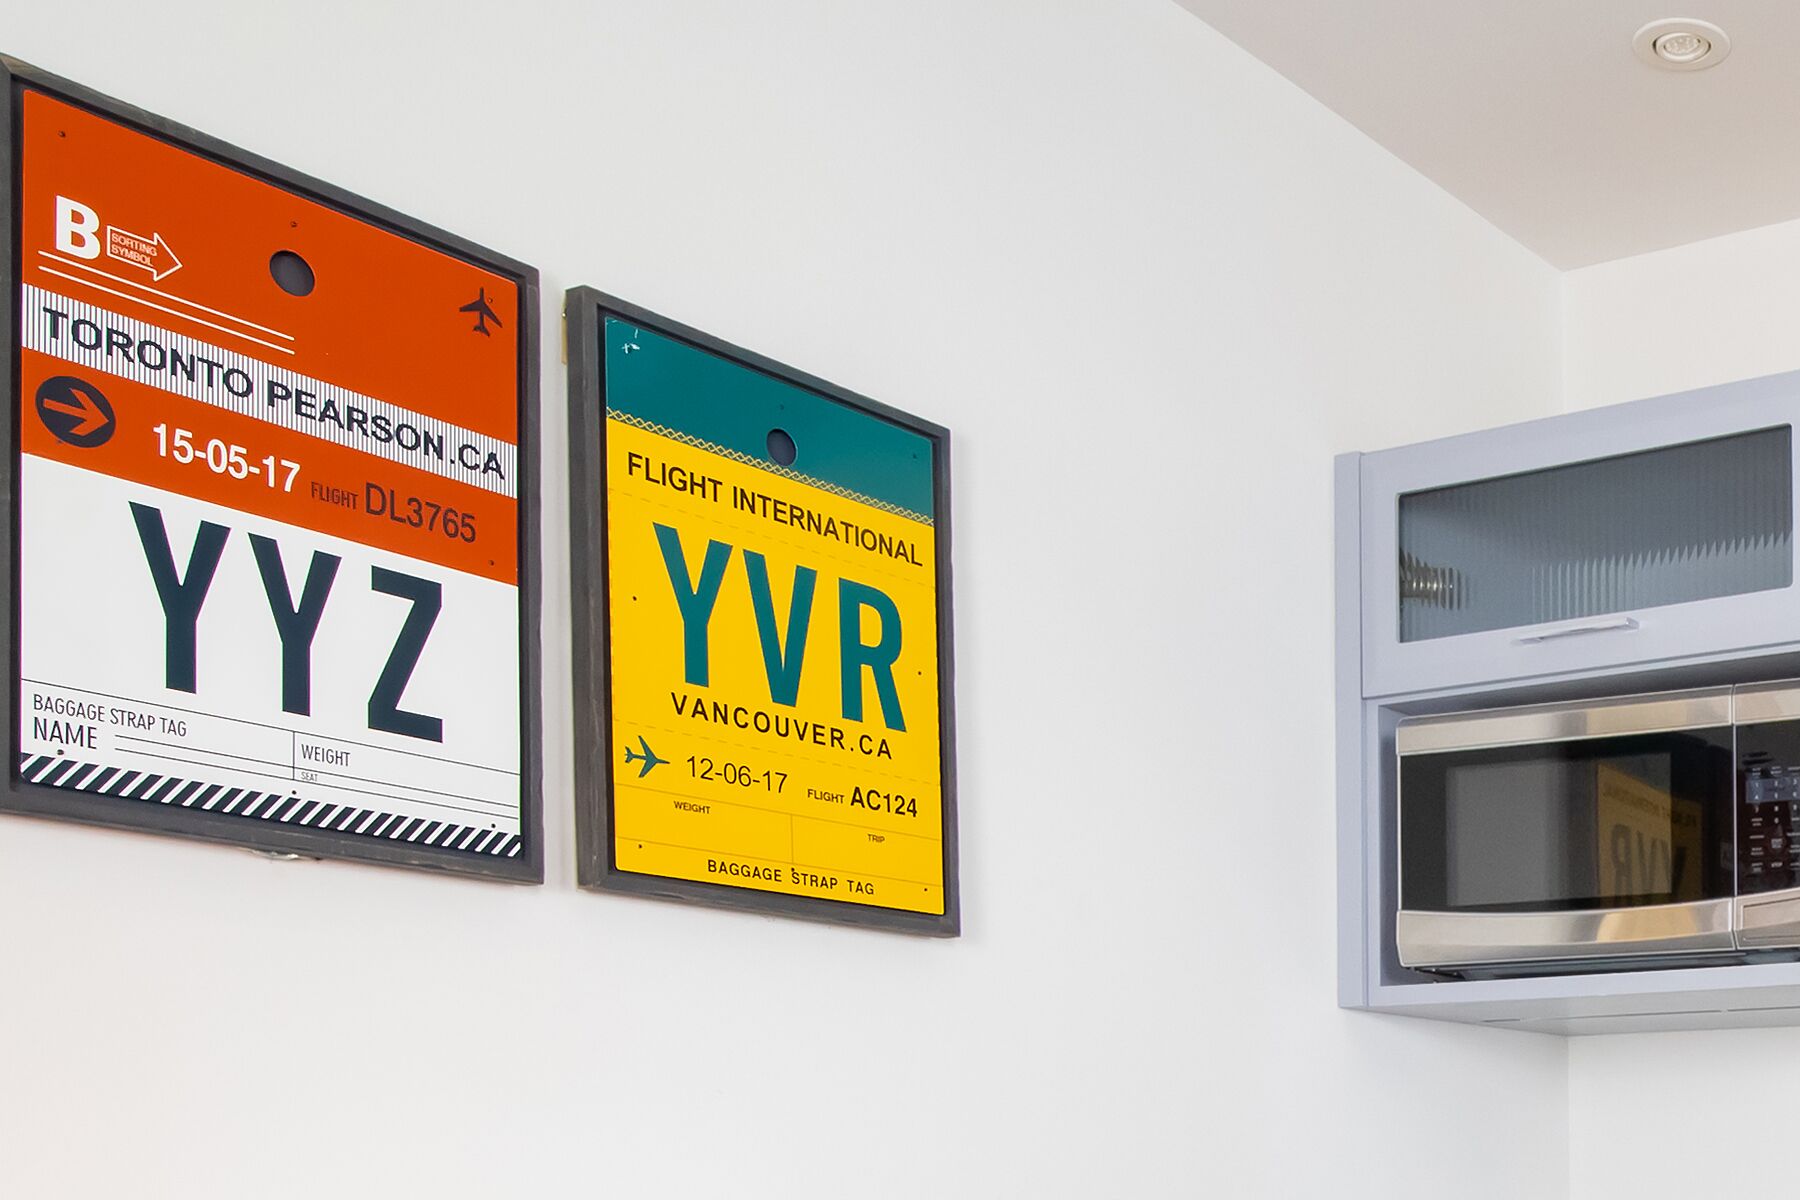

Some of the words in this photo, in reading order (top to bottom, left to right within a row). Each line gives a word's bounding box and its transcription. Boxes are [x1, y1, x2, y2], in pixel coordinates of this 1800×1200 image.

[55, 195, 101, 261] B
[111, 232, 157, 256] SORTING
[111, 244, 154, 267] SYMBOL
[43, 307, 253, 399] TORONTO
[267, 381, 505, 481] PEARSON.CA
[152, 423, 301, 493] 15-05-17
[310, 481, 359, 510] FLIGHT
[365, 483, 477, 543] DL3765
[627, 452, 723, 503] FLIGHT
[733, 485, 923, 567] INTERNATIONAL
[128, 501, 444, 743] YYZ
[652, 522, 907, 732] YVR
[33, 694, 106, 724] BAGGAGE
[110, 708, 156, 732] STRAP
[160, 717, 187, 738] TAG
[33, 717, 97, 750] NAME
[671, 692, 892, 760] VANCOUVER.CA
[301, 744, 351, 767] WEIGHT
[301, 772, 318, 781] SEAT
[673, 800, 711, 815] WEIGHT
[686, 755, 788, 794] 12-06-17
[807, 788, 845, 804] FLIGHT
[850, 786, 918, 818] AC124
[867, 833, 885, 843] TRIP
[707, 858, 783, 882] BAGGAGE
[791, 871, 838, 890] STRAP
[847, 879, 875, 896] TAG
